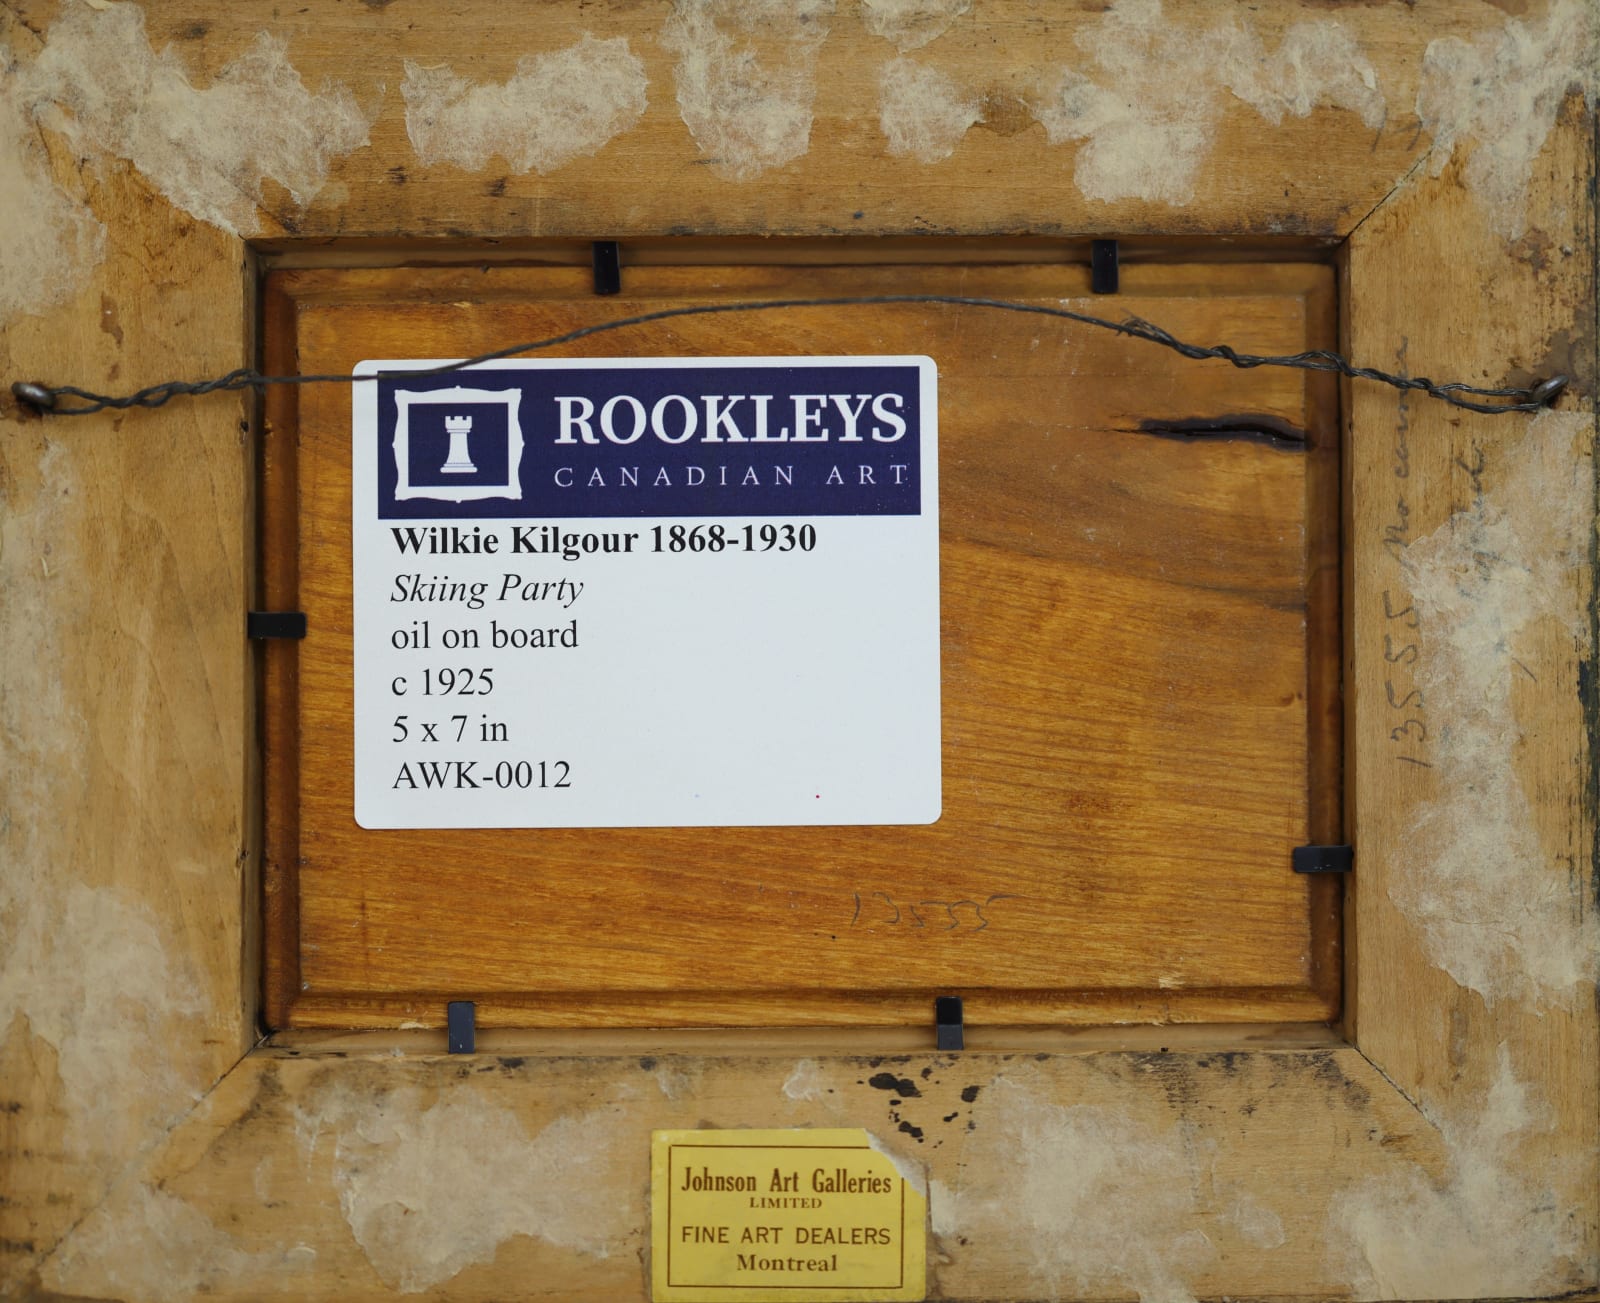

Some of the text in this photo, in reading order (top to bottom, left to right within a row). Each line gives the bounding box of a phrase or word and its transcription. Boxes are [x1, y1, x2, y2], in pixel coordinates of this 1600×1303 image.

[554, 393, 907, 445] ROOKLEYS
[554, 464, 907, 488] CANADIAN ART
[390, 523, 817, 562] Wilkie Kilgour 1868-1930
[390, 573, 584, 610] Skiing Party
[391, 619, 579, 650] oil on board
[391, 668, 493, 696] c 1925
[1382, 589, 1432, 768] 13555
[392, 714, 508, 743] 5 x 7 in
[392, 760, 571, 789] AWK-0012
[681, 1166, 892, 1194] Johnson Art Galleries
[749, 1196, 823, 1209] LIMITED
[682, 1225, 891, 1245] FINE ART DEALERS
[736, 1254, 837, 1272] Montreal
